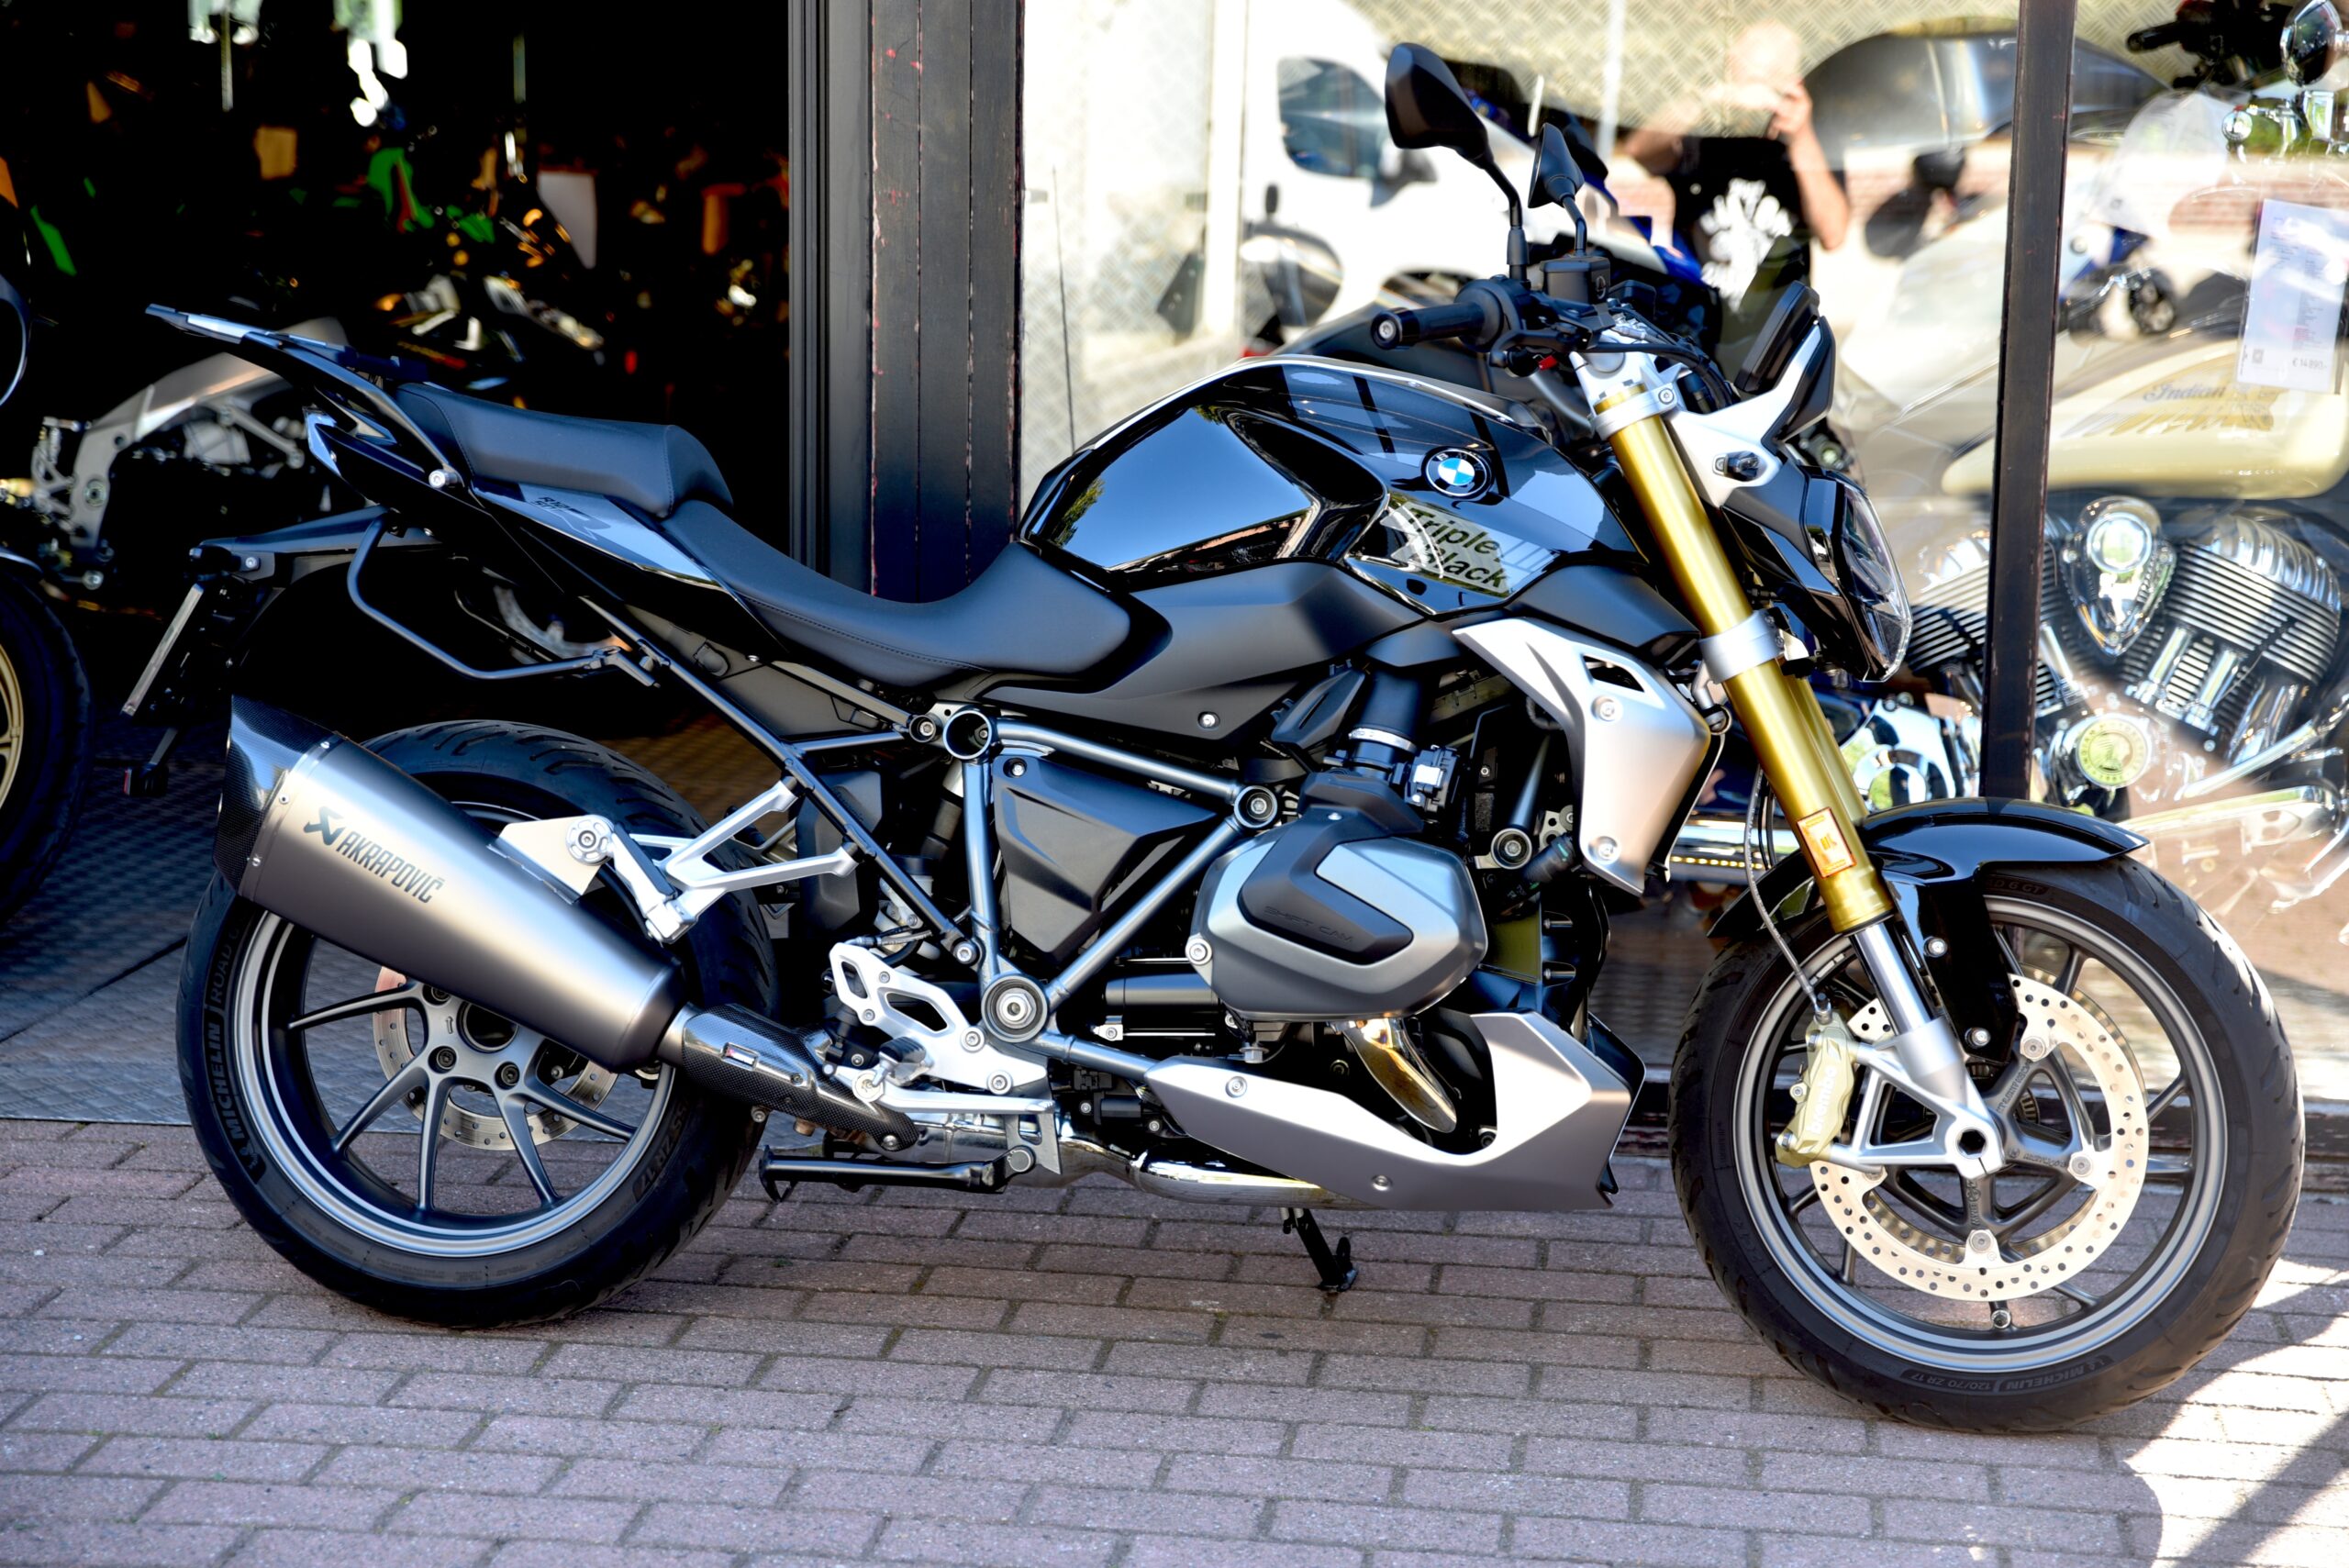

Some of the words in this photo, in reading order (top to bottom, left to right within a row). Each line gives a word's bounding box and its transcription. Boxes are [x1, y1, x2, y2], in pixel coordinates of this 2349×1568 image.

[1408, 507, 1500, 554] Triple
[207, 1021, 245, 1140] MICHELIN
[1805, 1064, 1838, 1135] brembo
[1911, 1373, 1925, 1382] 17
[1928, 1376, 1943, 1386] ZR
[1947, 1379, 1992, 1391] 120/70
[2006, 1366, 2085, 1390] MICHELIN
